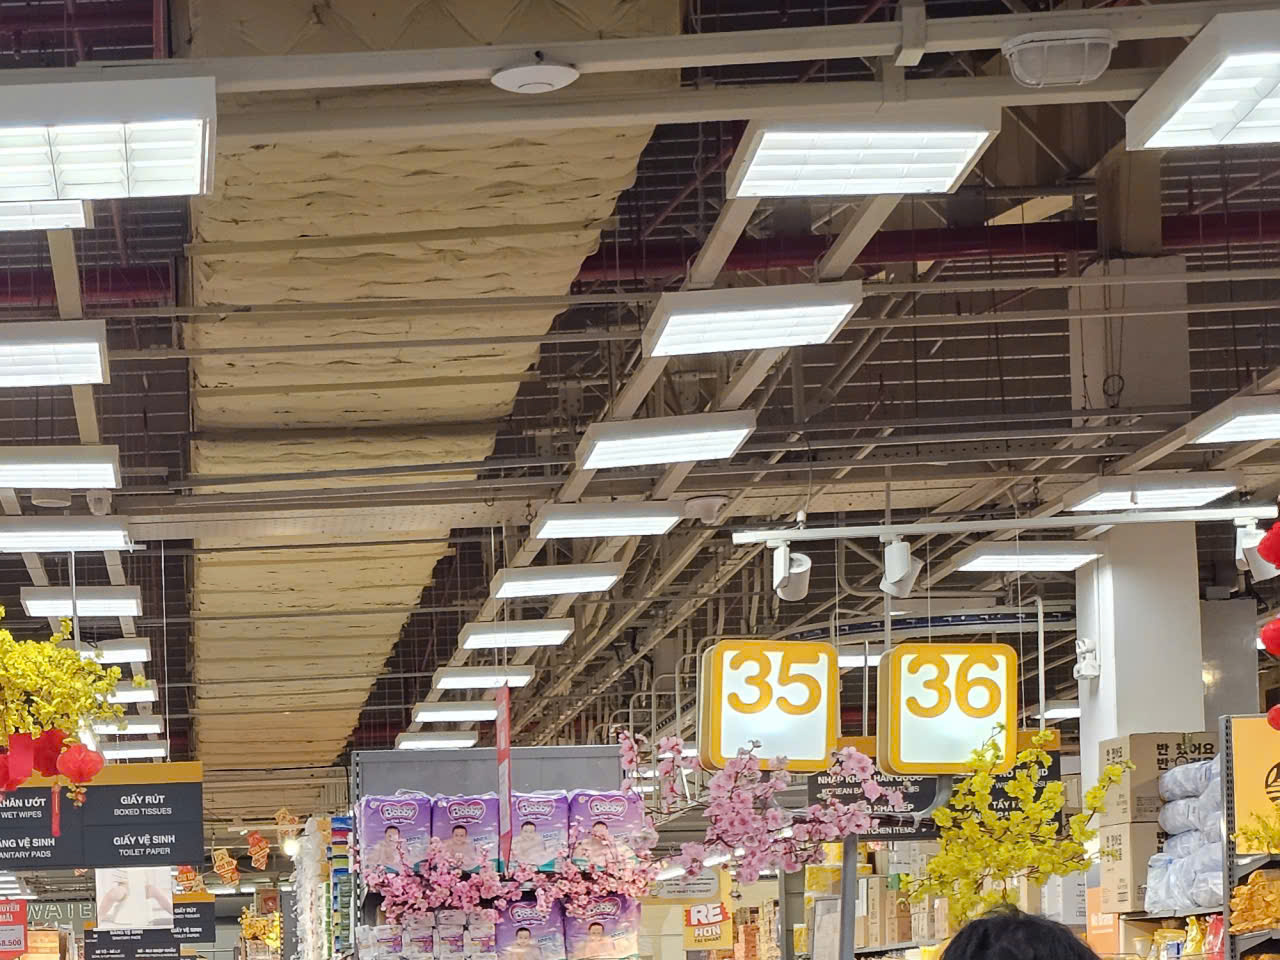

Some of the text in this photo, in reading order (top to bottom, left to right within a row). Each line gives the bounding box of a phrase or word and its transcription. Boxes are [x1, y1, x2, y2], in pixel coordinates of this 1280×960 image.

[726, 650, 822, 716] 35
[905, 650, 1002, 719] 36
[26, 797, 46, 807] ƯỚT
[121, 793, 165, 805] GIẤY RÚT
[114, 808, 139, 816] BOXED
[384, 805, 416, 817] Bobby
[452, 804, 483, 817] Bobby
[521, 801, 552, 813] Bobby
[1, 810, 42, 819] WET WIPES
[18, 838, 31, 849] VỆ
[32, 838, 55, 847] SINH
[114, 835, 175, 846] GIẤY VỆ SINH
[30, 850, 51, 858] PADS
